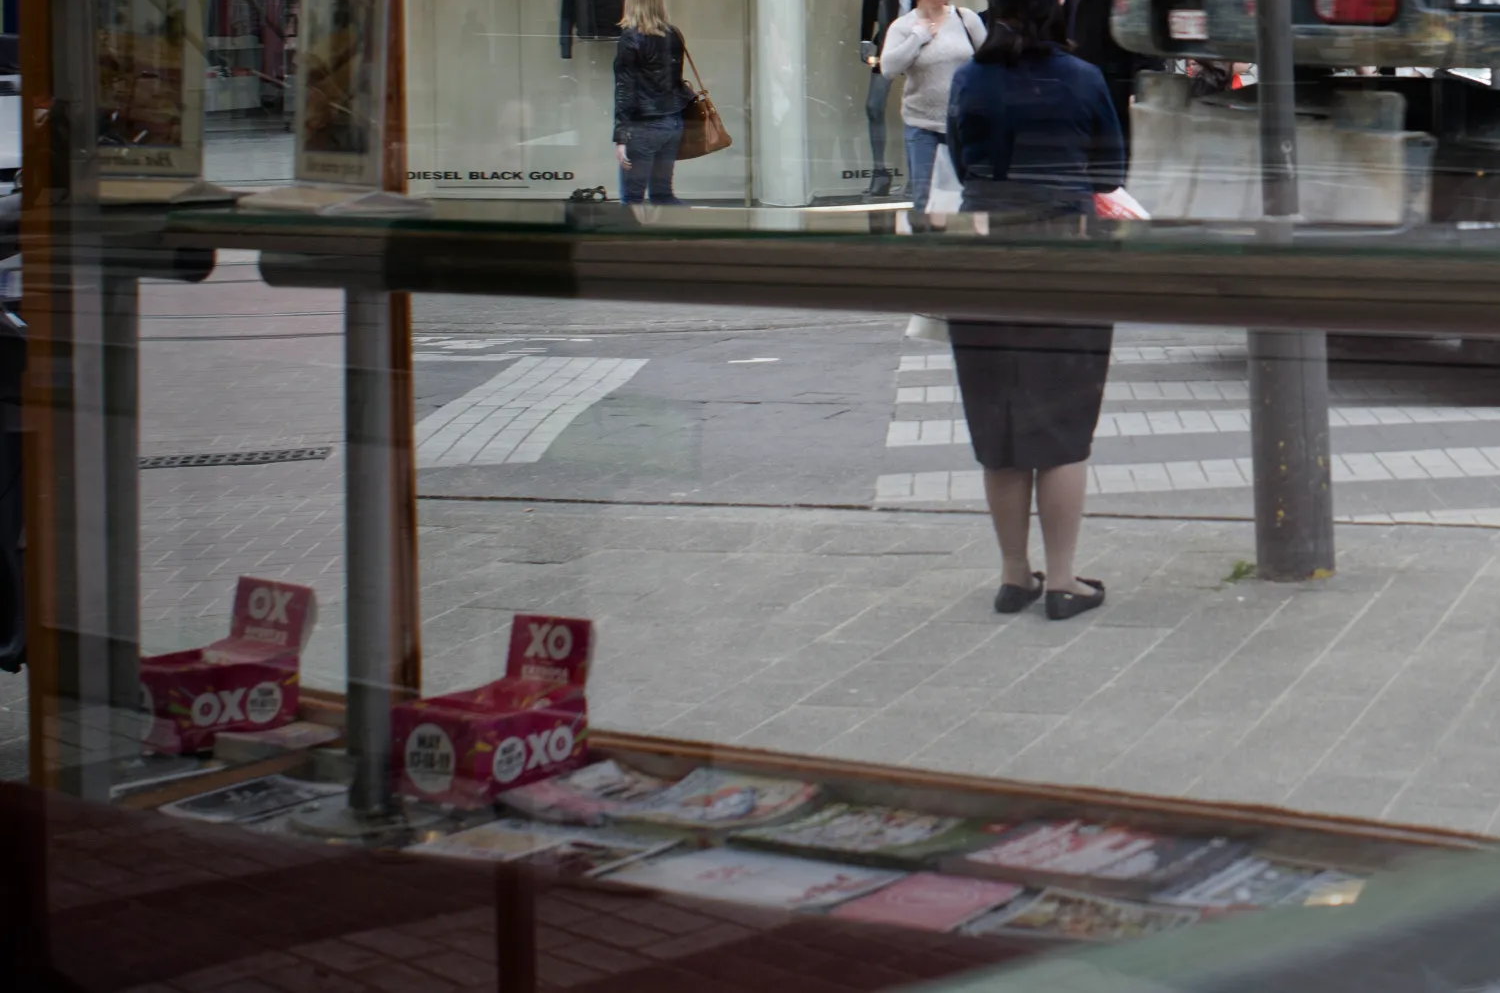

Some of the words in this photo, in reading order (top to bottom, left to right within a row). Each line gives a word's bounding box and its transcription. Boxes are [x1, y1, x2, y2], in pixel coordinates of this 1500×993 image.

[407, 171, 462, 180] DIESEL
[469, 171, 523, 180] BLACK
[529, 171, 574, 180] GOLD
